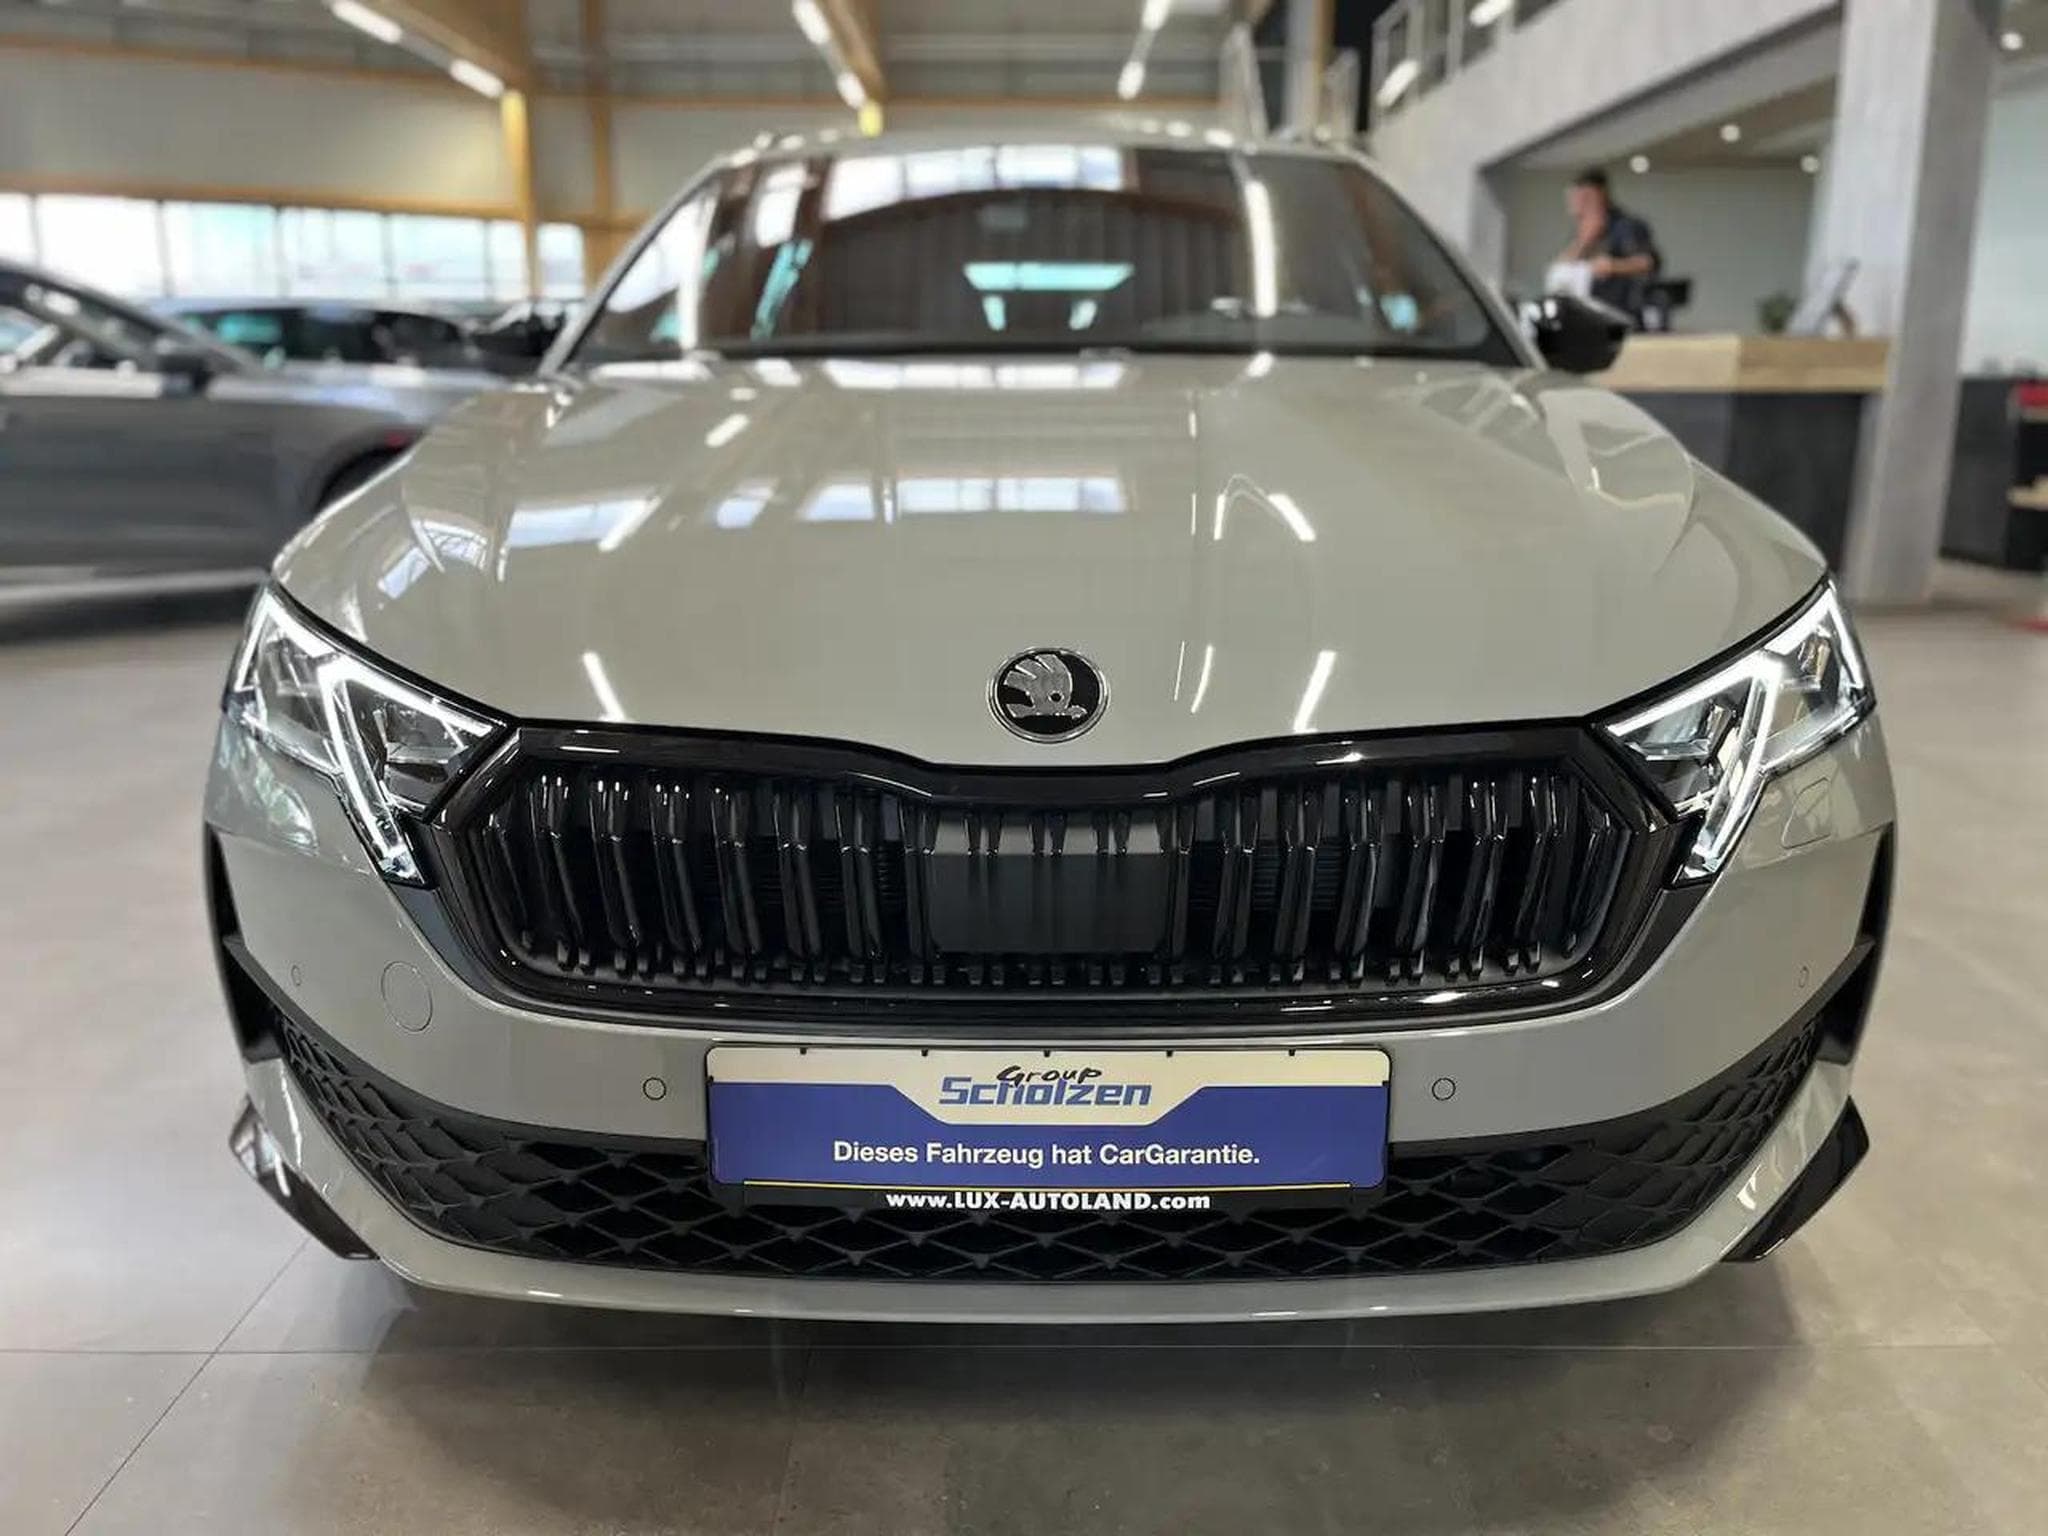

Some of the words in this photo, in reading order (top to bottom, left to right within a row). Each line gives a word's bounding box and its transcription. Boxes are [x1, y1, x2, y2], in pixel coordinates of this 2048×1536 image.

[996, 1065, 1102, 1088] Group
[939, 1076, 1152, 1105] Scholzen
[834, 1141, 918, 1163] Dieses
[926, 1143, 1044, 1169] Fahrzeug
[1052, 1144, 1092, 1164] hat
[1100, 1144, 1260, 1164] CarGarantie.
[886, 1192, 1210, 1210] www.LUX-AUTOLAND.com
